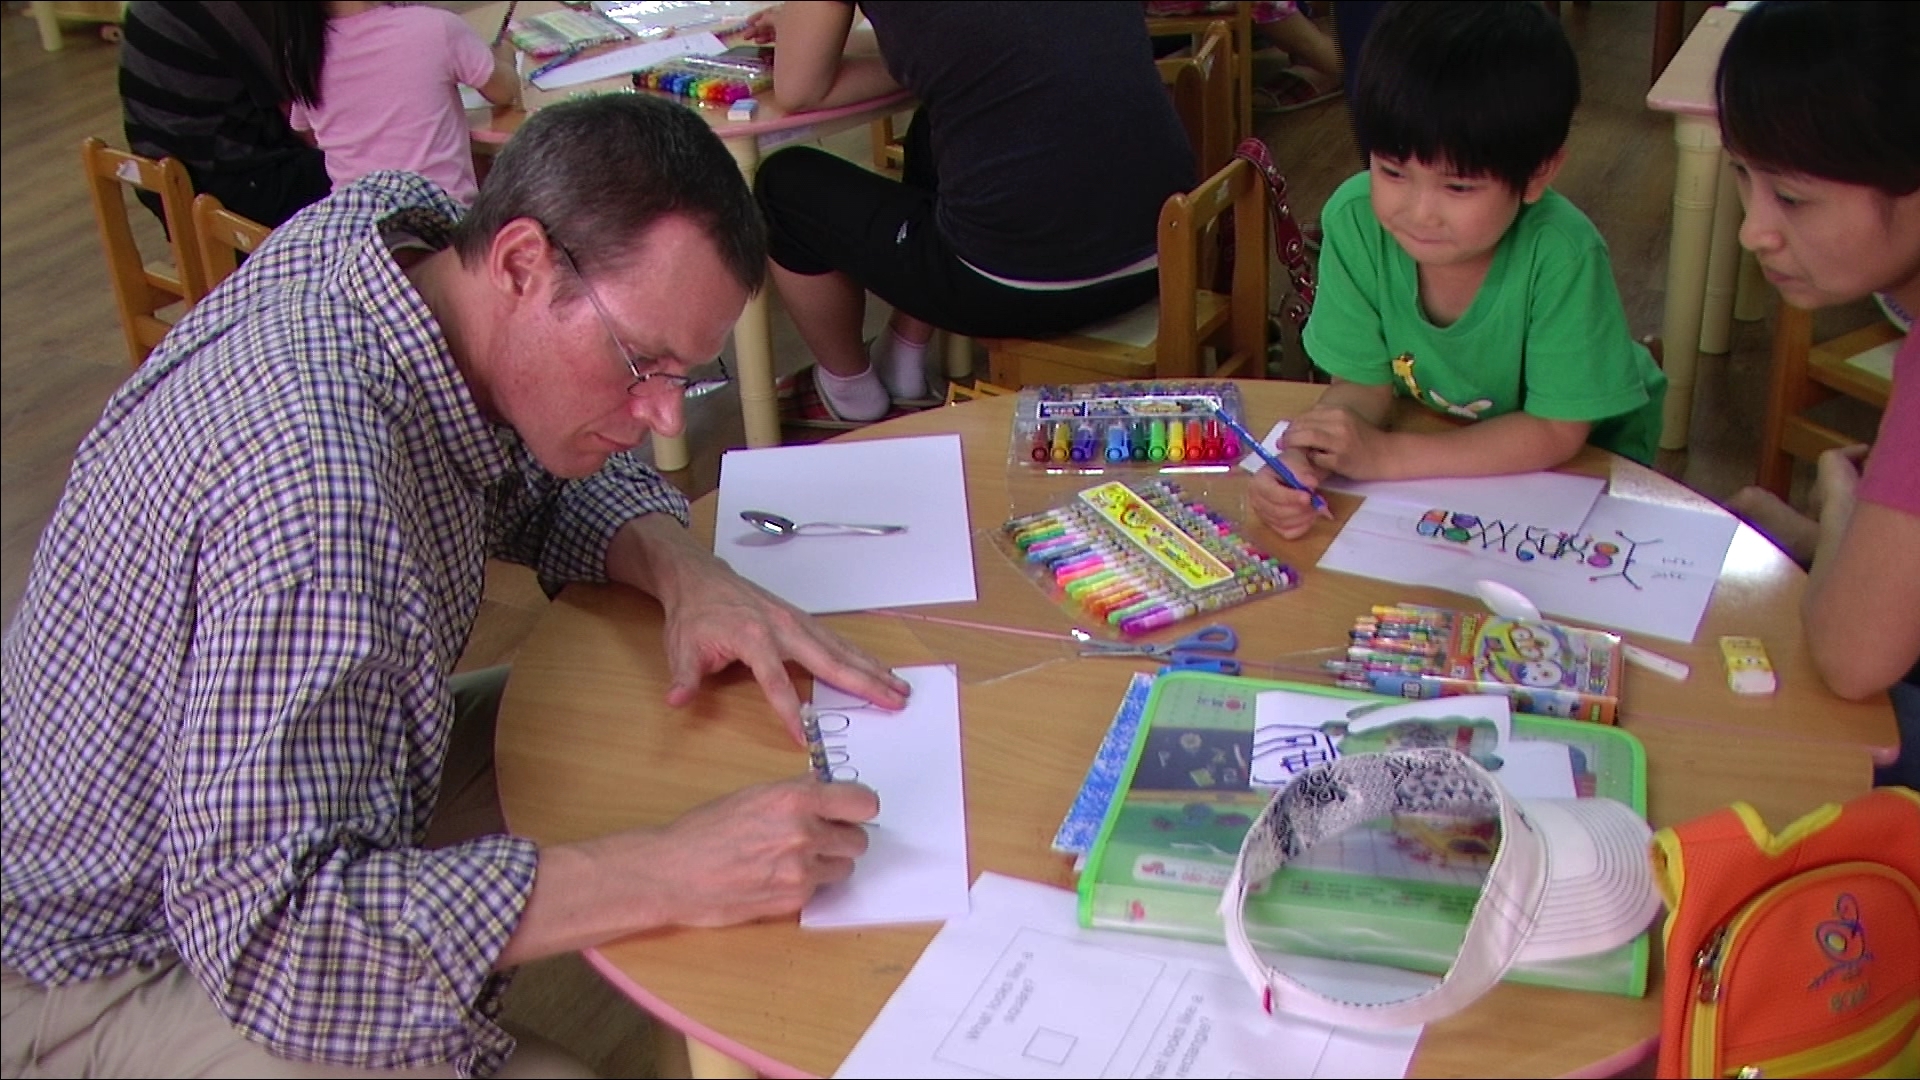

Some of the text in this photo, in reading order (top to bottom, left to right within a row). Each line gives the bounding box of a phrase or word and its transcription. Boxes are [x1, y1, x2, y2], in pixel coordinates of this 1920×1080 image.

[965, 1011, 992, 1041] What
[985, 981, 1014, 1010] looks
[1005, 961, 1025, 978] like
[1003, 978, 1034, 1023] square?
[1162, 1026, 1187, 1058] looks
[1177, 1004, 1198, 1025] like
[1176, 1015, 1211, 1079] rectangle?
